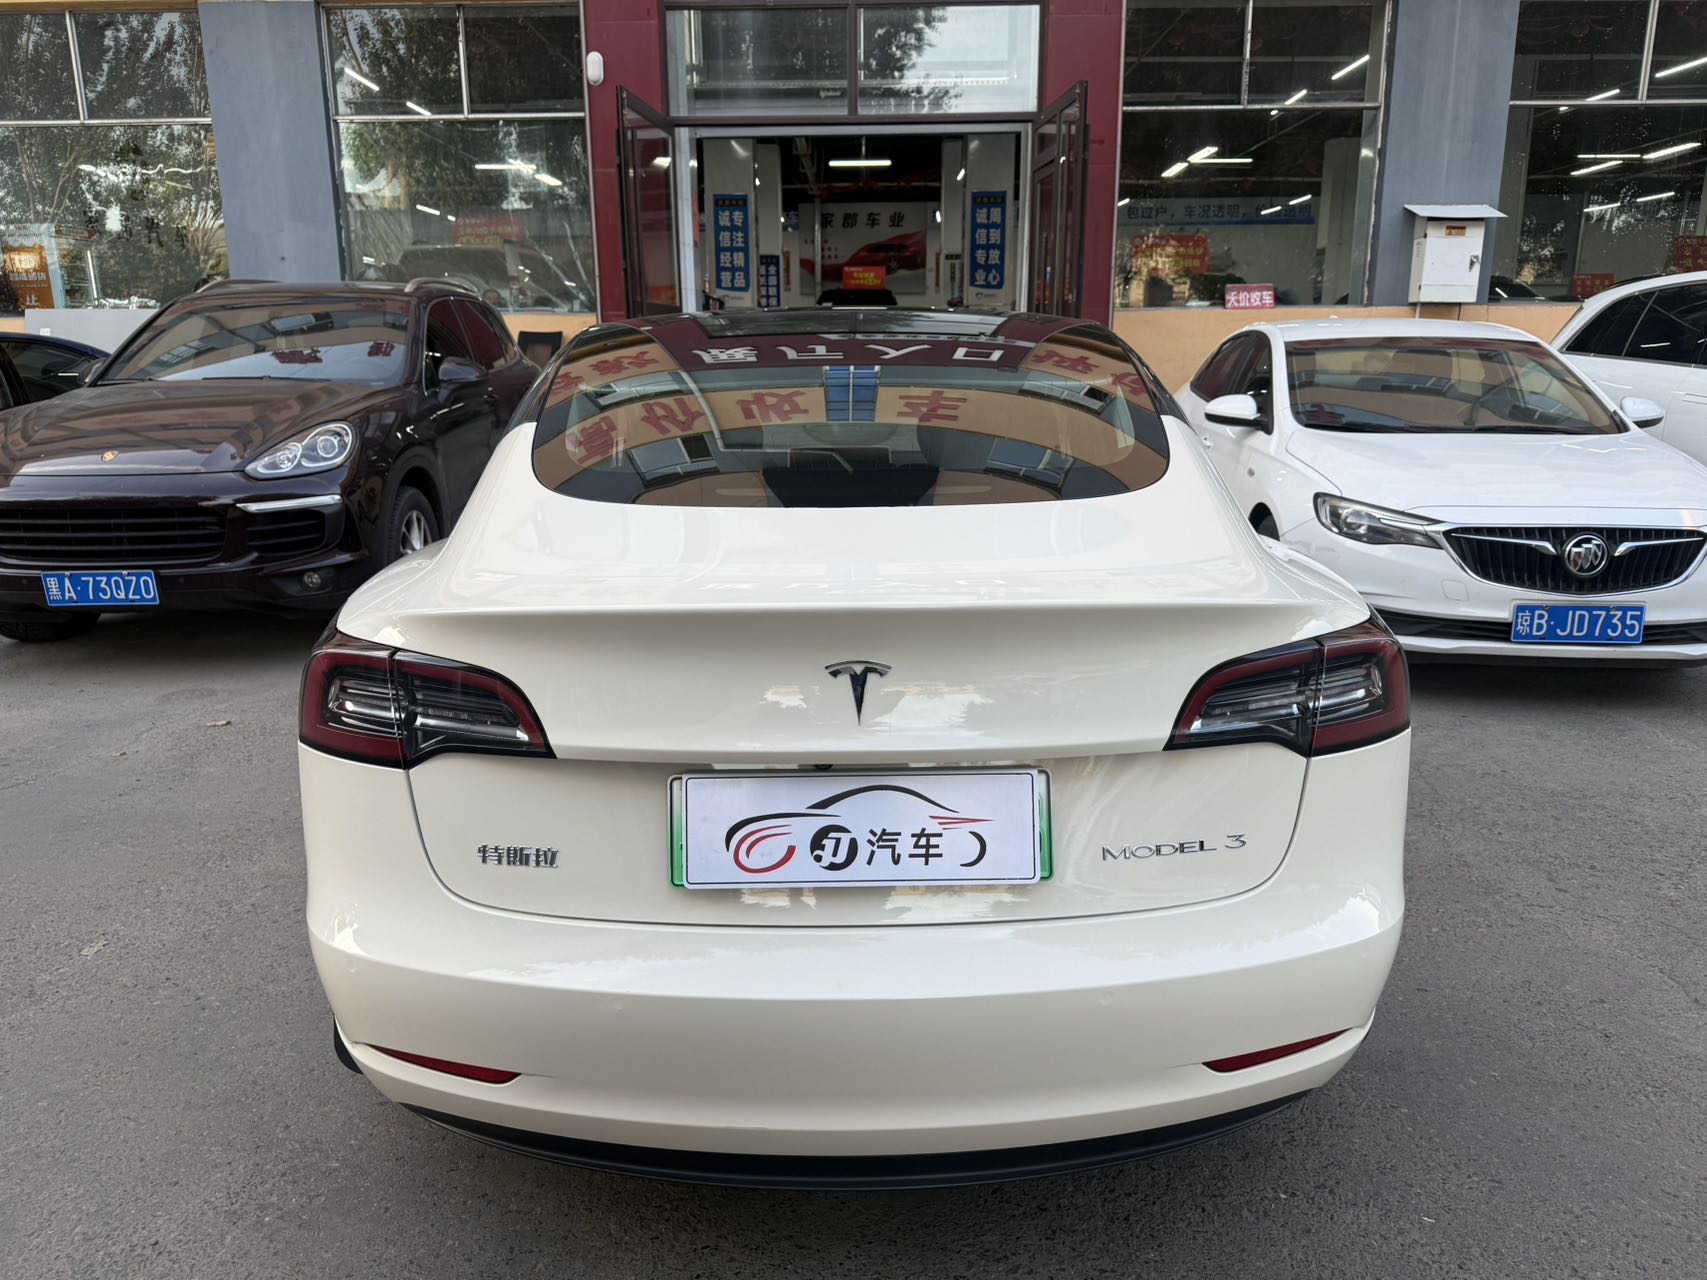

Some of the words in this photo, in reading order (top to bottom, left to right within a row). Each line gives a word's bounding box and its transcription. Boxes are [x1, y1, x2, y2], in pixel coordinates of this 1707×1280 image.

[719, 210, 732, 288] 诚信经营
[732, 210, 745, 288] 专注精品
[974, 208, 988, 285] 诚信专业
[987, 208, 1001, 285] 周到放心
[477, 844, 559, 869] 特斯拉
[866, 827, 944, 866] 汽车
[1102, 840, 1217, 861] MODEL
[1225, 833, 1247, 849] 3
